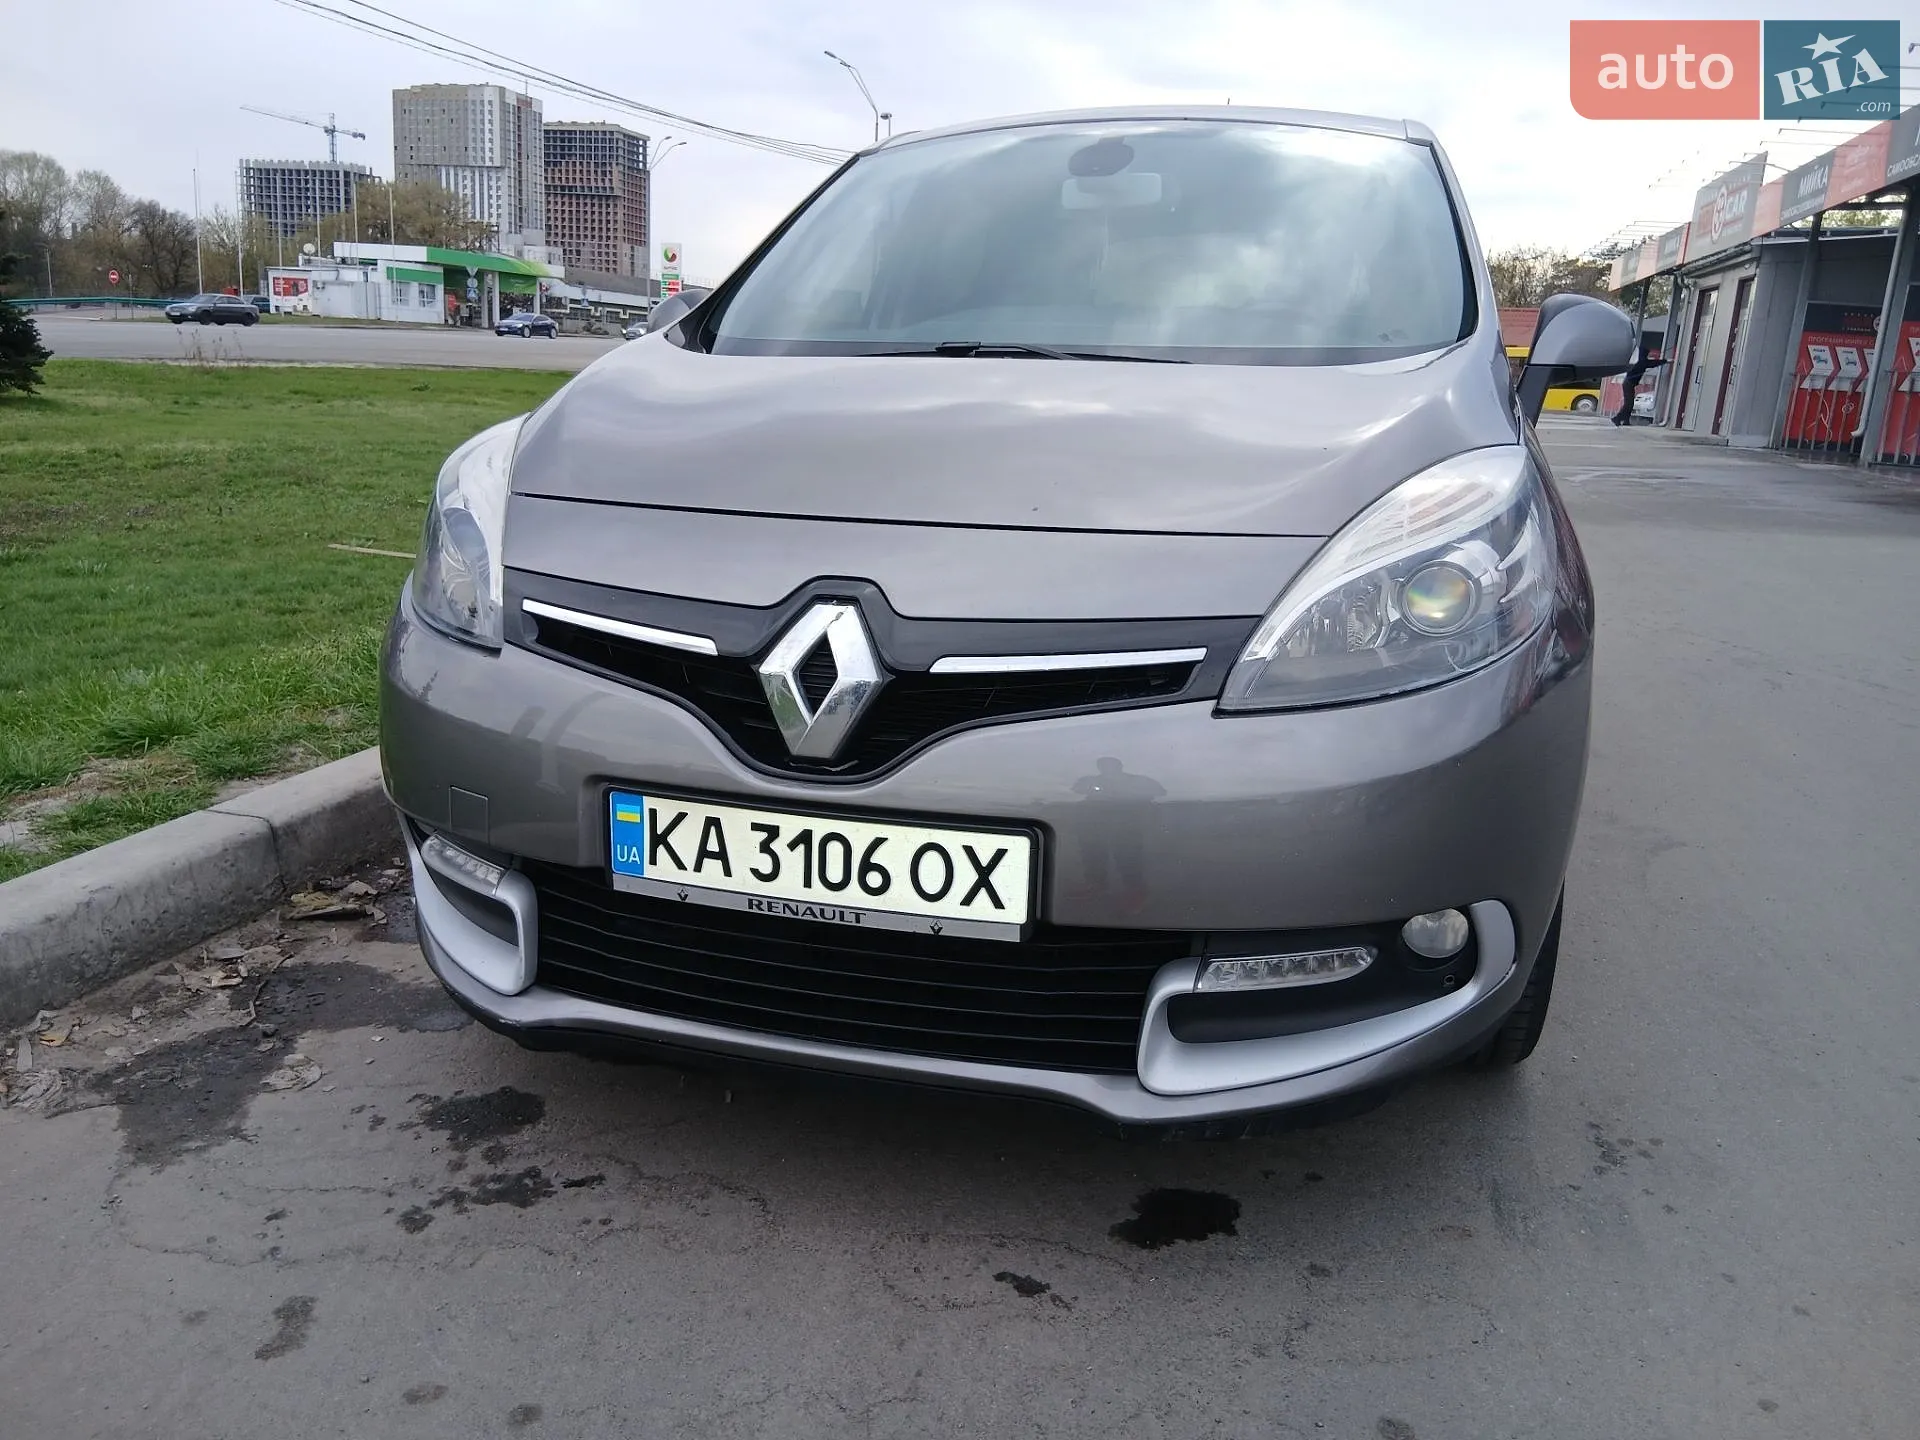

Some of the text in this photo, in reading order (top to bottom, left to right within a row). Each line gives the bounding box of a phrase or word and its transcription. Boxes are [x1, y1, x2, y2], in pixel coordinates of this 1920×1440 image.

[1798, 164, 1829, 199] МИЙКА
[616, 844, 641, 865] UA
[648, 807, 1009, 910] KA 3106 OX
[747, 898, 867, 925] RENAULT
